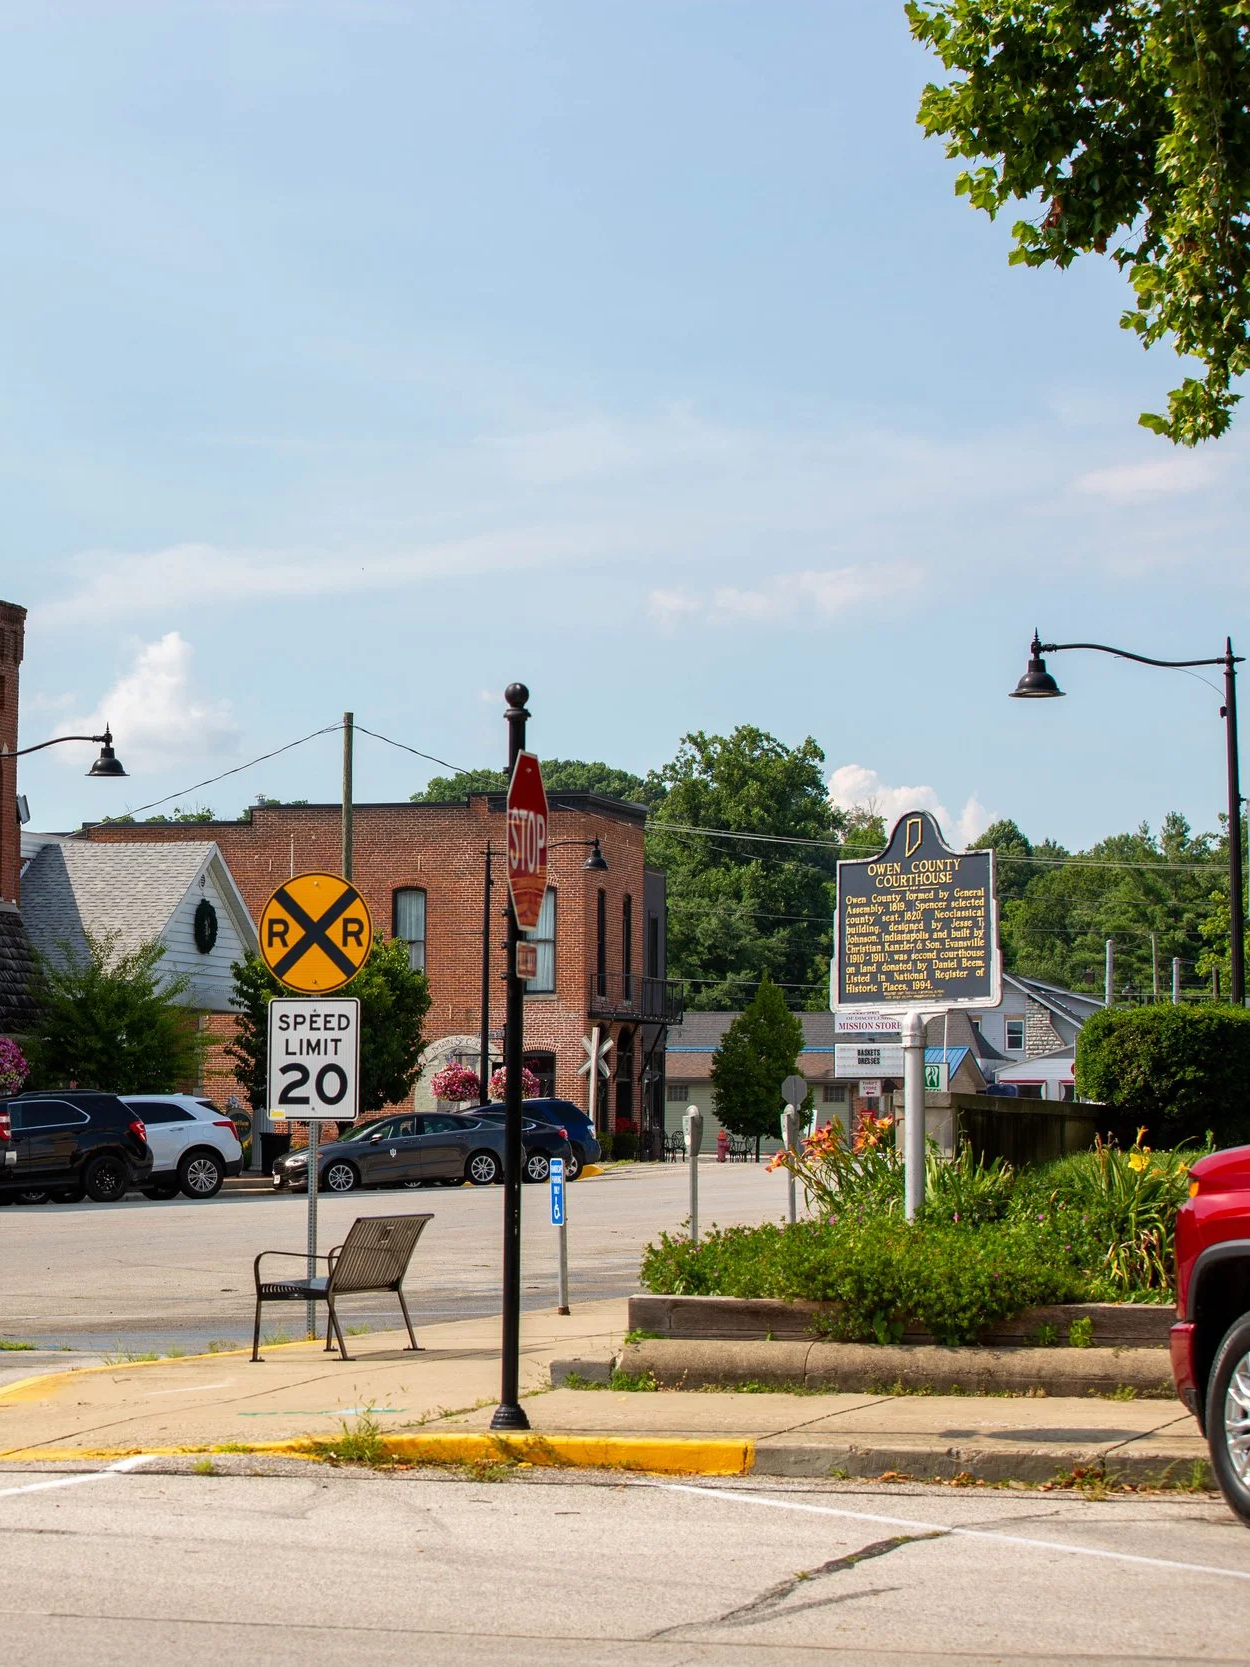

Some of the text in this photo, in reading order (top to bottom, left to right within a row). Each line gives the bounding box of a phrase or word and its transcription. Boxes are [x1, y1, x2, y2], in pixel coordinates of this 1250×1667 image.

[509, 806, 546, 874] STOP
[867, 858, 961, 876] OWEN COUNTY
[875, 871, 953, 888] COURTHOUSE
[846, 887, 985, 905] Owen County formed by General
[889, 901, 907, 912] 1819.
[915, 900, 947, 911] Spencer
[950, 897, 985, 908] selected
[846, 914, 875, 925] county
[904, 910, 924, 921] 1820.
[934, 907, 985, 919] Neoclassical
[267, 917, 364, 948] R R
[888, 921, 924, 932] designed
[931, 920, 942, 930] by
[950, 918, 973, 928] Jesse
[882, 931, 929, 942] Indianapolis
[932, 929, 947, 939] and
[951, 928, 970, 938] built
[973, 928, 984, 938] by
[846, 944, 882, 954] Christian
[884, 941, 914, 951] Kanzler
[916, 940, 923, 950] &
[945, 938, 985, 948] Evansville
[911, 950, 937, 960] second
[940, 949, 985, 958] courthouse
[846, 966, 855, 974] on
[860, 963, 876, 973] land
[881, 961, 912, 972] donated
[917, 961, 928, 971] by
[932, 959, 957, 969] Daniel
[846, 967, 985, 983] Listed in National Register of
[846, 983, 878, 993] Historic
[912, 980, 933, 990] 1994.
[277, 1013, 351, 1032] SPEED
[838, 1022, 902, 1031] MISSION STORE
[284, 1038, 343, 1057] LIMIT
[857, 1057, 881, 1065] DRESSES
[277, 1062, 348, 1106] 20
